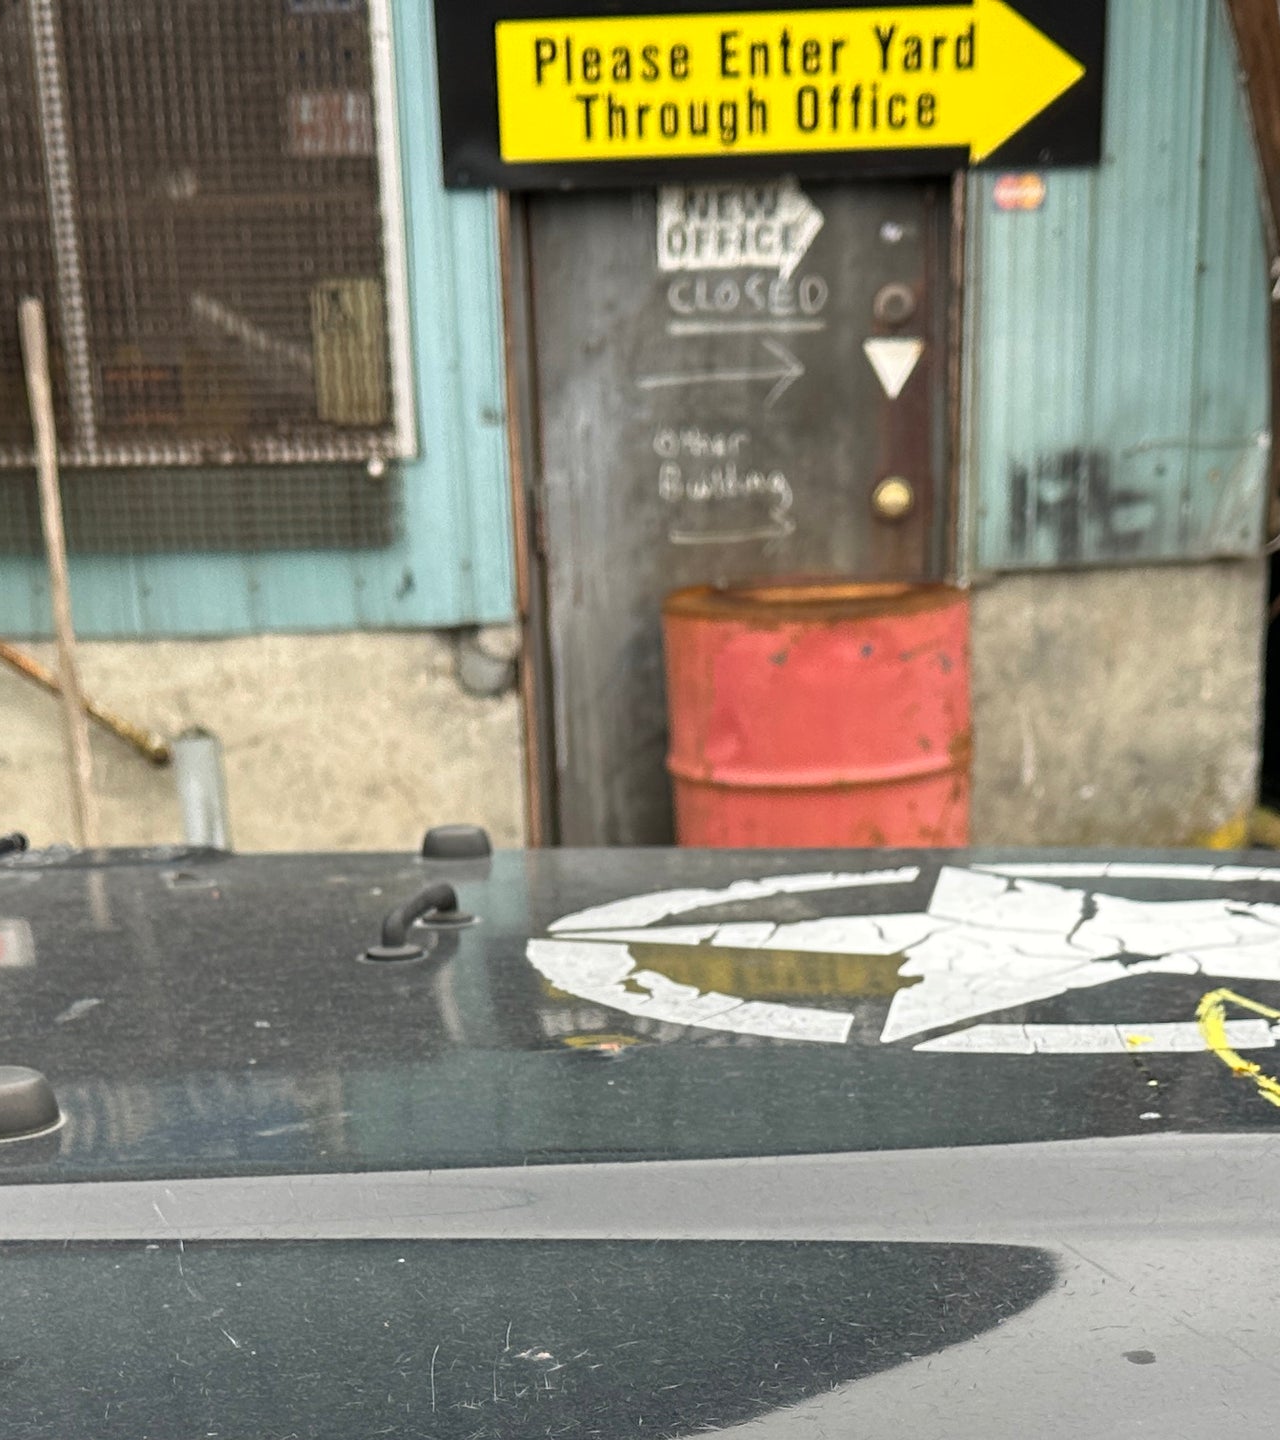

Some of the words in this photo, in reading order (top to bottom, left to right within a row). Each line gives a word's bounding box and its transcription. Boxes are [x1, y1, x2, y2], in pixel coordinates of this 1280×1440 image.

[533, 35, 692, 86] Please
[719, 27, 846, 79] Enter
[873, 20, 977, 73] Yard
[575, 87, 769, 145] Through
[795, 82, 939, 133] Office
[667, 272, 829, 317] CLOSED
